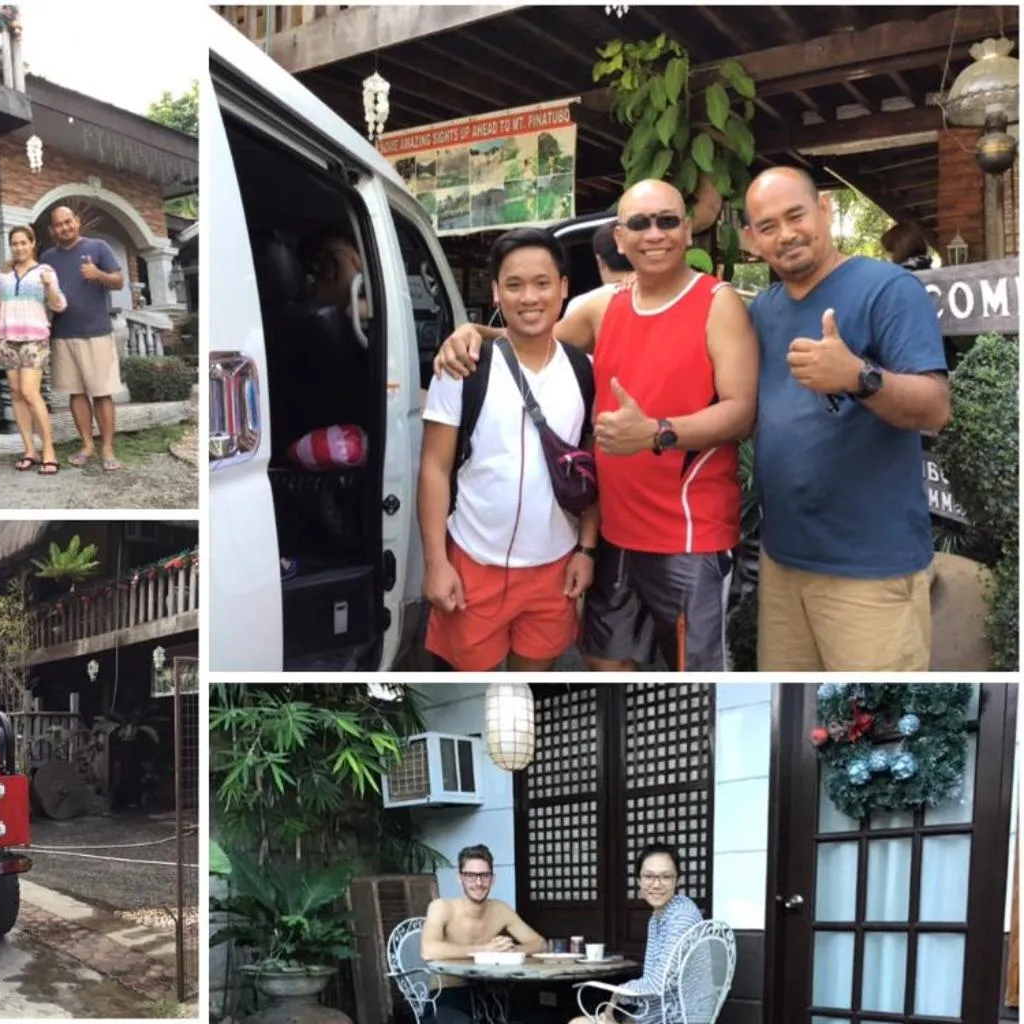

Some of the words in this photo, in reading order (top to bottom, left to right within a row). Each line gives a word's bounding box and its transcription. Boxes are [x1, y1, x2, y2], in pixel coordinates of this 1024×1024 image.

[432, 128, 458, 145] SIGHTS
[460, 125, 471, 139] UP
[472, 120, 497, 136] AHEAD
[498, 119, 510, 133] TO
[527, 108, 570, 127] PINATUBO
